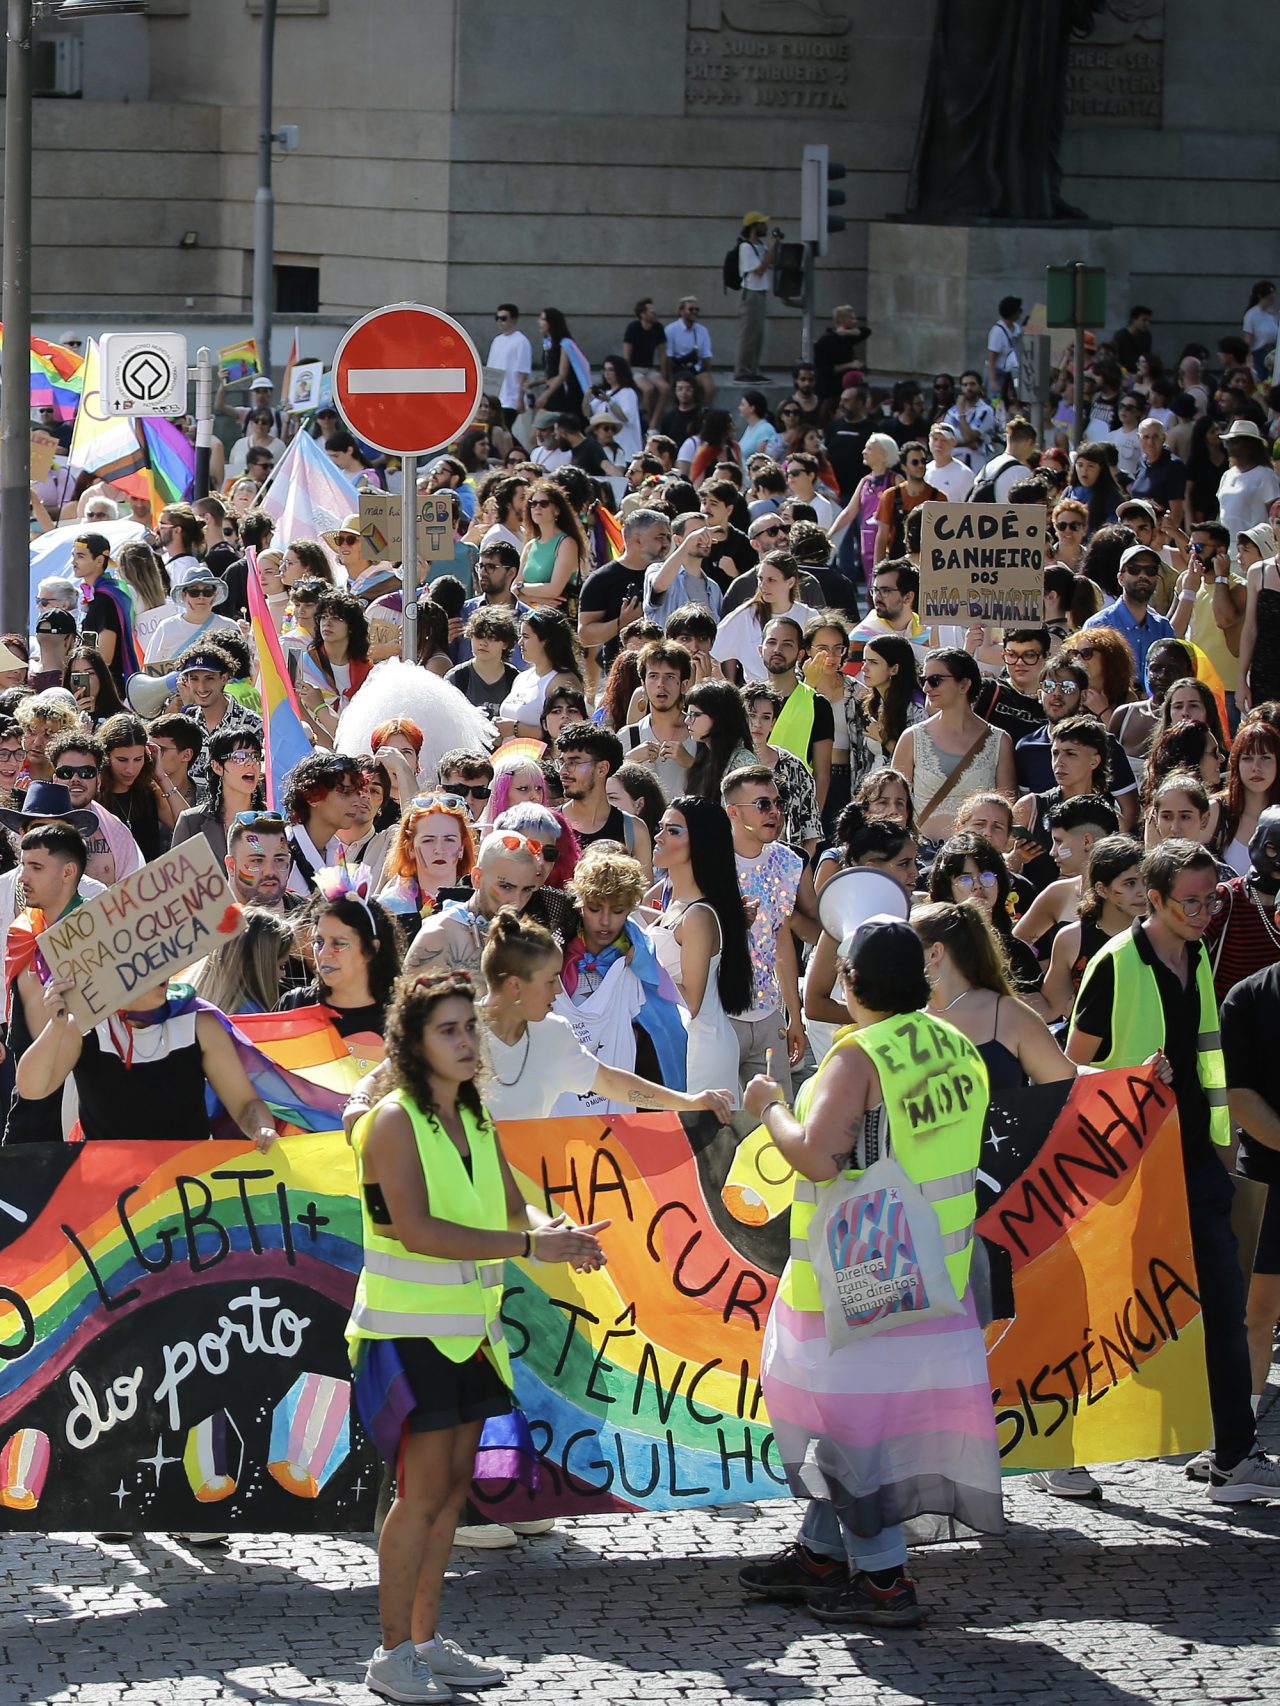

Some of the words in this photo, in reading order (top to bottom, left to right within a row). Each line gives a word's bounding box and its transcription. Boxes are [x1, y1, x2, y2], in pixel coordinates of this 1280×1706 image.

[426, 526, 446, 551] T
[934, 510, 1019, 541] CADÊ
[931, 547, 1042, 571] BANHEIRO
[971, 571, 999, 585] DOS
[48, 908, 95, 959] NÃO
[99, 880, 140, 928] HÁ
[137, 854, 200, 902] CURA
[56, 940, 116, 985] PARA
[113, 928, 132, 954] O
[80, 975, 106, 1015] É
[115, 915, 210, 992] DOENÇA
[875, 1022, 981, 1074] EZRA
[540, 1126, 634, 1228] HÁ
[646, 1200, 768, 1332] CUR
[999, 1075, 1167, 1258] MINHA
[60, 1168, 330, 1312] LGBTI+
[835, 1260, 885, 1284] Direitos
[866, 1276, 918, 1299] direitos
[842, 1292, 900, 1318] humanos
[65, 1365, 144, 1450] do
[153, 1285, 312, 1431] porto
[500, 1286, 765, 1427] STÊNCI
[993, 1256, 1201, 1459] SISTÊNCIA
[472, 1418, 787, 1501] RGULHO
